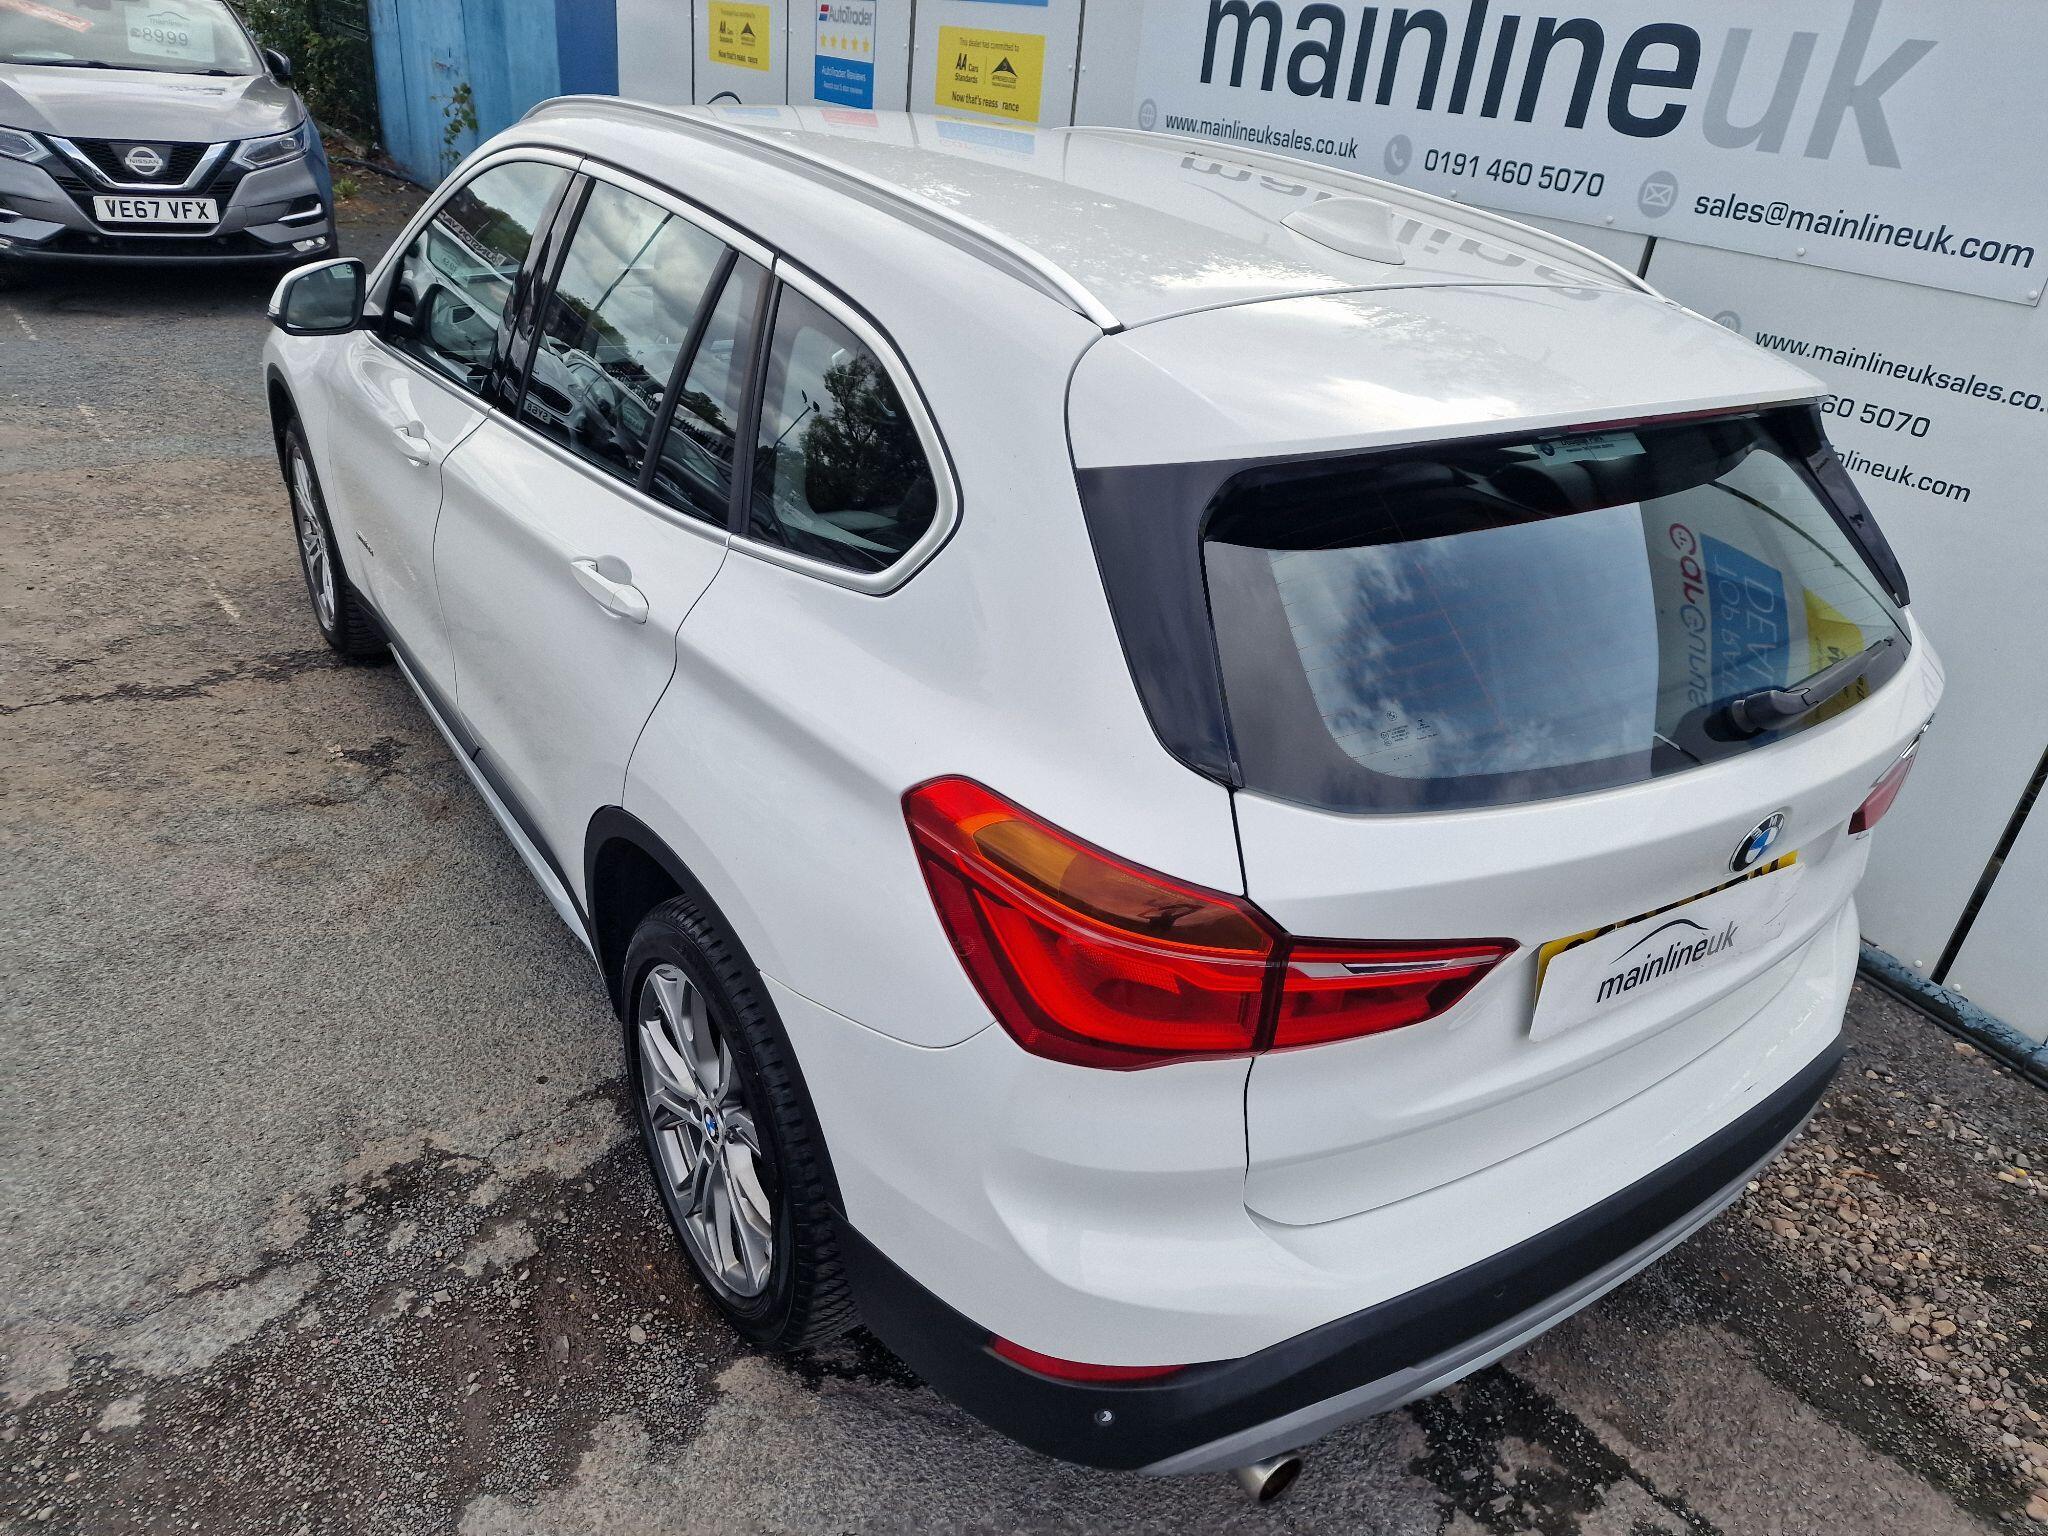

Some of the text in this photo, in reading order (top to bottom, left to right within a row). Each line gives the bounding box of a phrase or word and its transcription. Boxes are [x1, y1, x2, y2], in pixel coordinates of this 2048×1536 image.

[829, 6, 873, 26] AutoTrader
[955, 53, 979, 73] AA Cars
[955, 73, 978, 84] Standards
[952, 91, 965, 103] Now
[965, 94, 982, 106] that's
[1200, 0, 1938, 170] mainlineuk
[1165, 112, 1358, 159] www.mainlineuksales.co.uk
[129, 158, 160, 166] NISSAN
[1423, 149, 1606, 198] 0191 460 5070
[104, 199, 209, 220] VE67 VFX
[1694, 193, 2035, 269] sales@mainlineuk.com
[1755, 331, 2048, 414] www.mainlineuksales.co.
[1860, 403, 1931, 438] 5070
[1832, 445, 1971, 503] nlineuk.com
[1596, 921, 1739, 1003] mainlineuk
